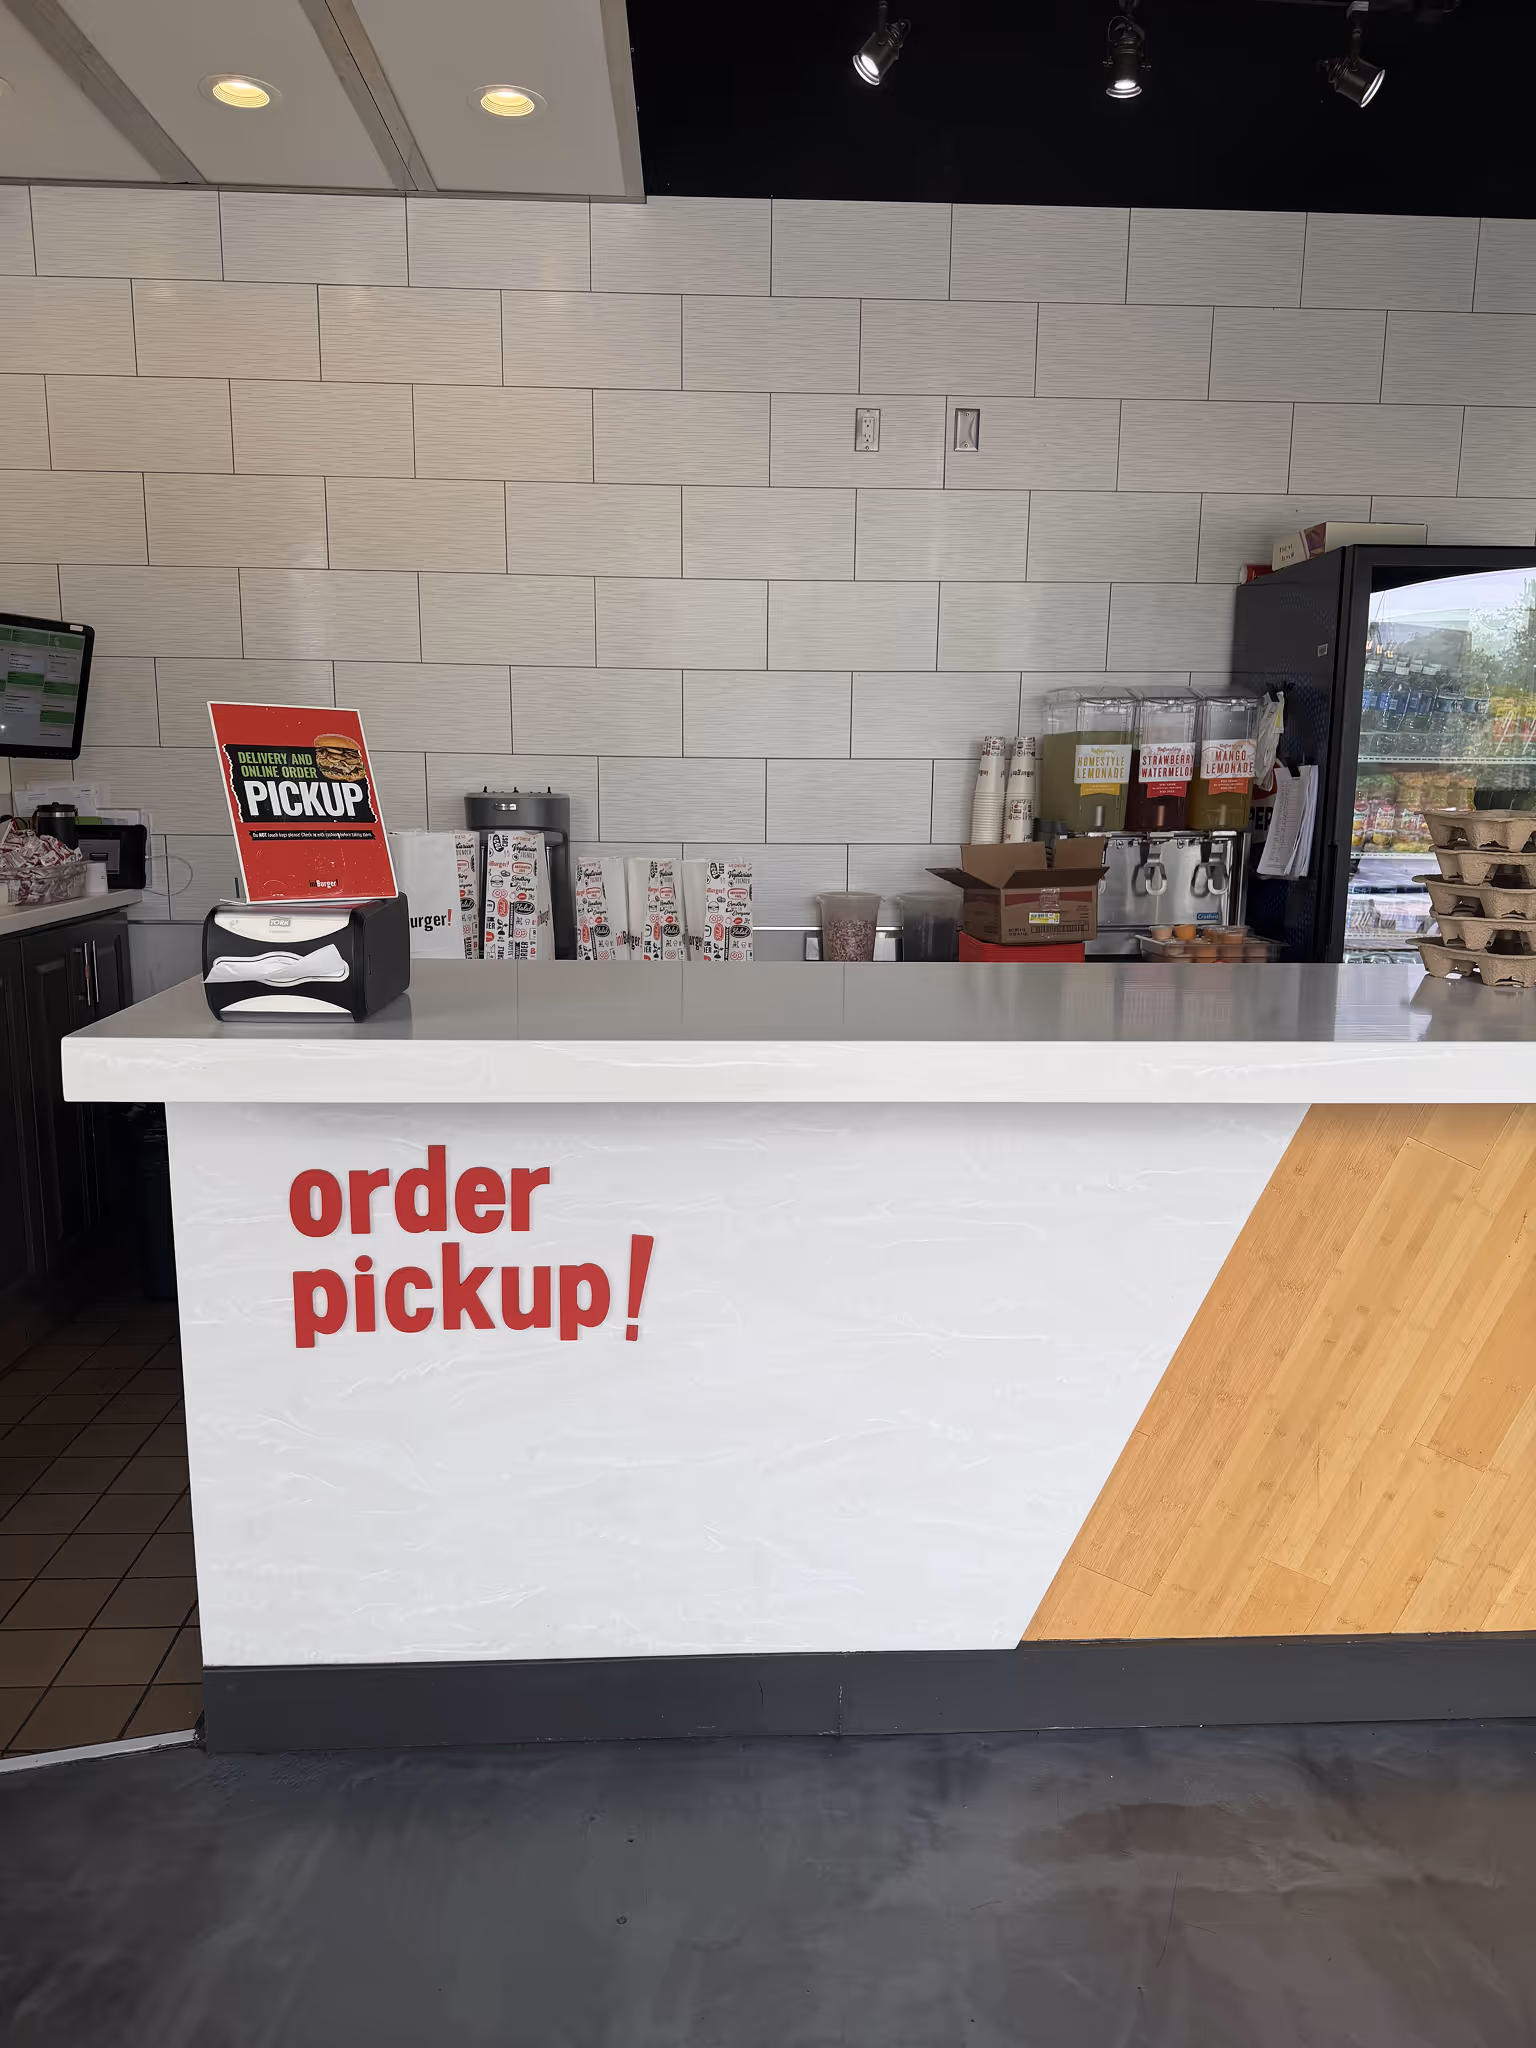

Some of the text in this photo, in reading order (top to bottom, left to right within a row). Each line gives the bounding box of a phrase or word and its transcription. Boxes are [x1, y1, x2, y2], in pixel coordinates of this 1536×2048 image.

[237, 751, 313, 765] DELIVERY AND
[1077, 756, 1125, 767] HOMESTYLE
[1215, 750, 1247, 761] MANGO
[240, 765, 318, 779] ONLINE ORDER
[1077, 767, 1125, 779] LEMONADE
[1206, 761, 1254, 774] LEMONADE
[243, 780, 364, 817] PICKUP
[410, 908, 452, 932] urger!
[289, 1144, 551, 1238] order
[292, 1233, 654, 1348] pickup!
